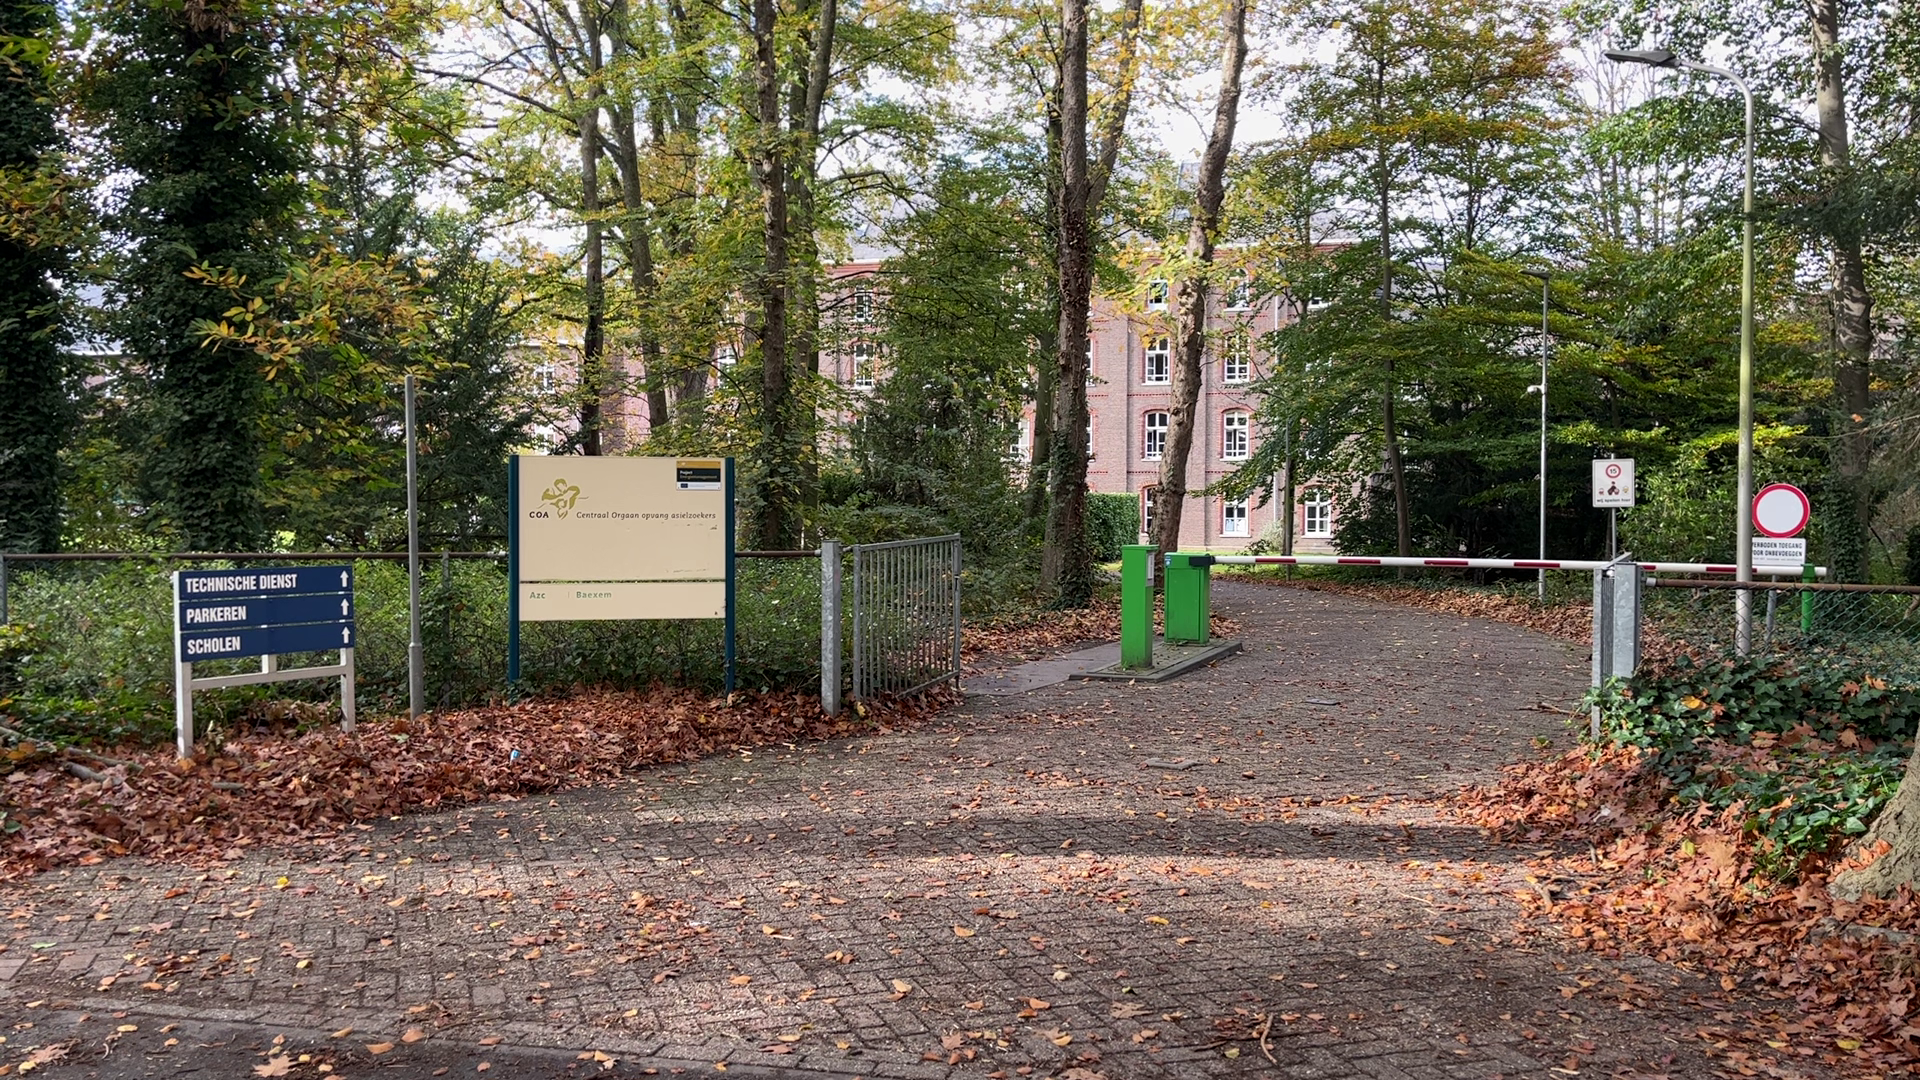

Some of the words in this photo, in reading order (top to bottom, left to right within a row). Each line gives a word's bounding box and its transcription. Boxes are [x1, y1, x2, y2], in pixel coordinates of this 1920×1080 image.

[529, 511, 549, 519] COA
[576, 511, 609, 519] Centraal
[611, 511, 640, 520] Orgaan
[641, 512, 669, 520] opvang
[671, 511, 716, 519] asielzoekers
[185, 575, 257, 593] TECHNISCHE
[260, 574, 298, 590] DIENST
[186, 606, 246, 624] PARKEREN
[187, 636, 240, 654] SCHOLEN
